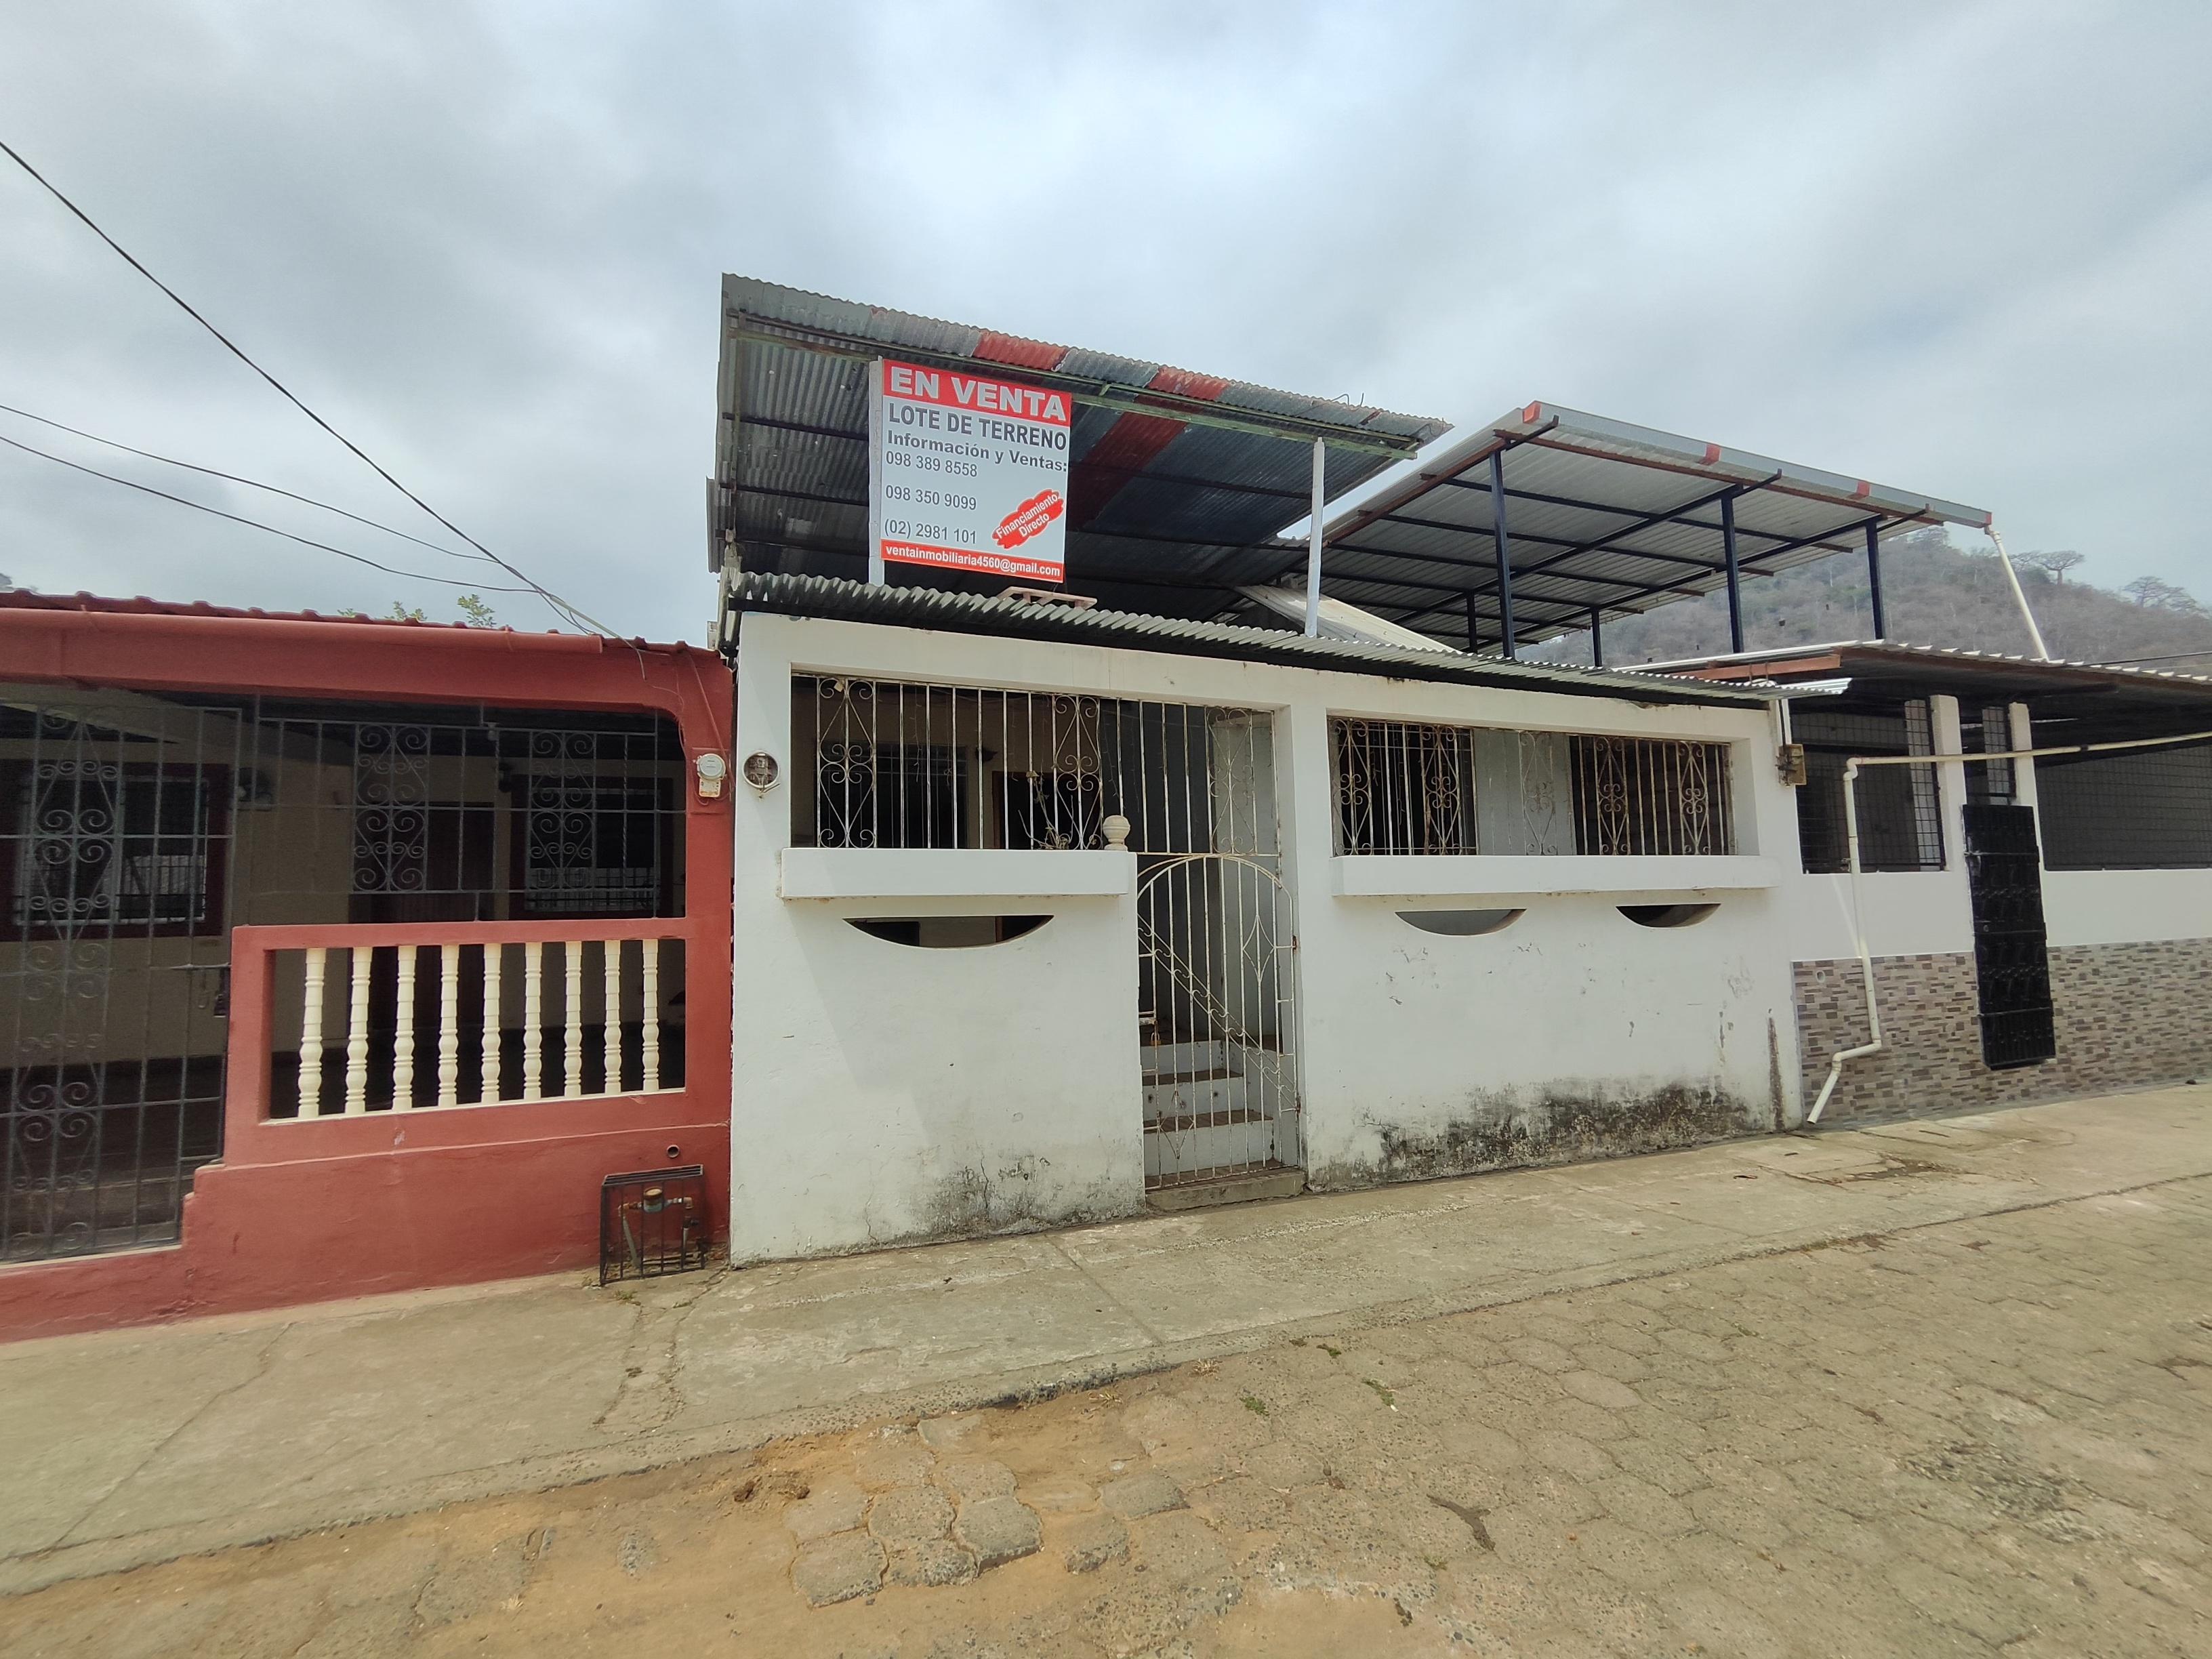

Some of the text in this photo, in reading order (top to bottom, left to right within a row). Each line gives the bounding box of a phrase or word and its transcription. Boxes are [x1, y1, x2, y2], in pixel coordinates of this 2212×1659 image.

[891, 367, 1066, 422] EN VENTA
[889, 403, 1066, 450] LOTE DE TERRENO
[886, 451, 977, 476] 098 389 8558
[888, 430, 1067, 472] Información y Ventas:
[886, 485, 977, 510] 098 350 9099
[996, 493, 1057, 539] Financiamiento
[1019, 513, 1050, 537] Directo
[884, 519, 976, 544] (02) 2981 101
[886, 546, 1060, 576] ventainmobiliaria4560@gmail.com
